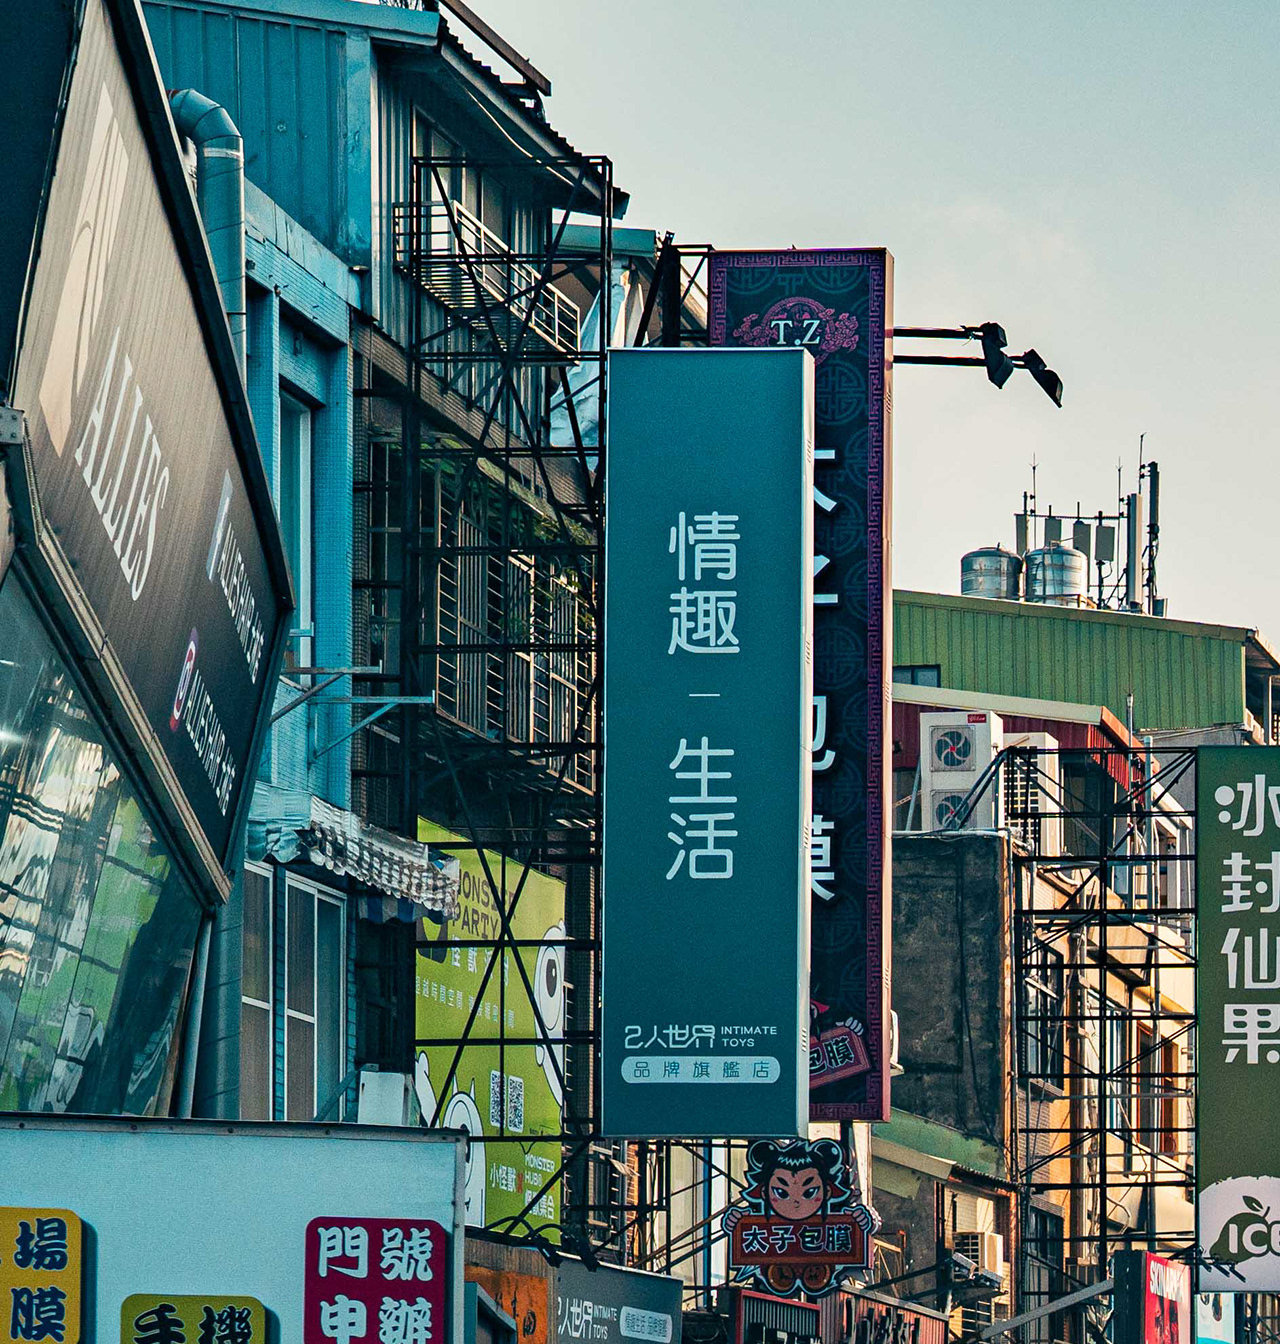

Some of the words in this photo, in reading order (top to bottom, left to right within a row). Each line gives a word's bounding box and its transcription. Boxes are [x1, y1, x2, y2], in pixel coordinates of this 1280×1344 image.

[74, 326, 170, 602] ALLIES
[667, 512, 741, 656] 情趣
[666, 737, 738, 880] 生活
[720, 1026, 778, 1036] INTIMATE
[721, 1038, 755, 1048] TOYS
[633, 1061, 770, 1079] 品牌旗艦店
[742, 1224, 852, 1254] 太子包膜
[316, 1226, 436, 1283] 門號
[593, 1305, 617, 1322] INTIMATE
[593, 1323, 609, 1341] TOYS
